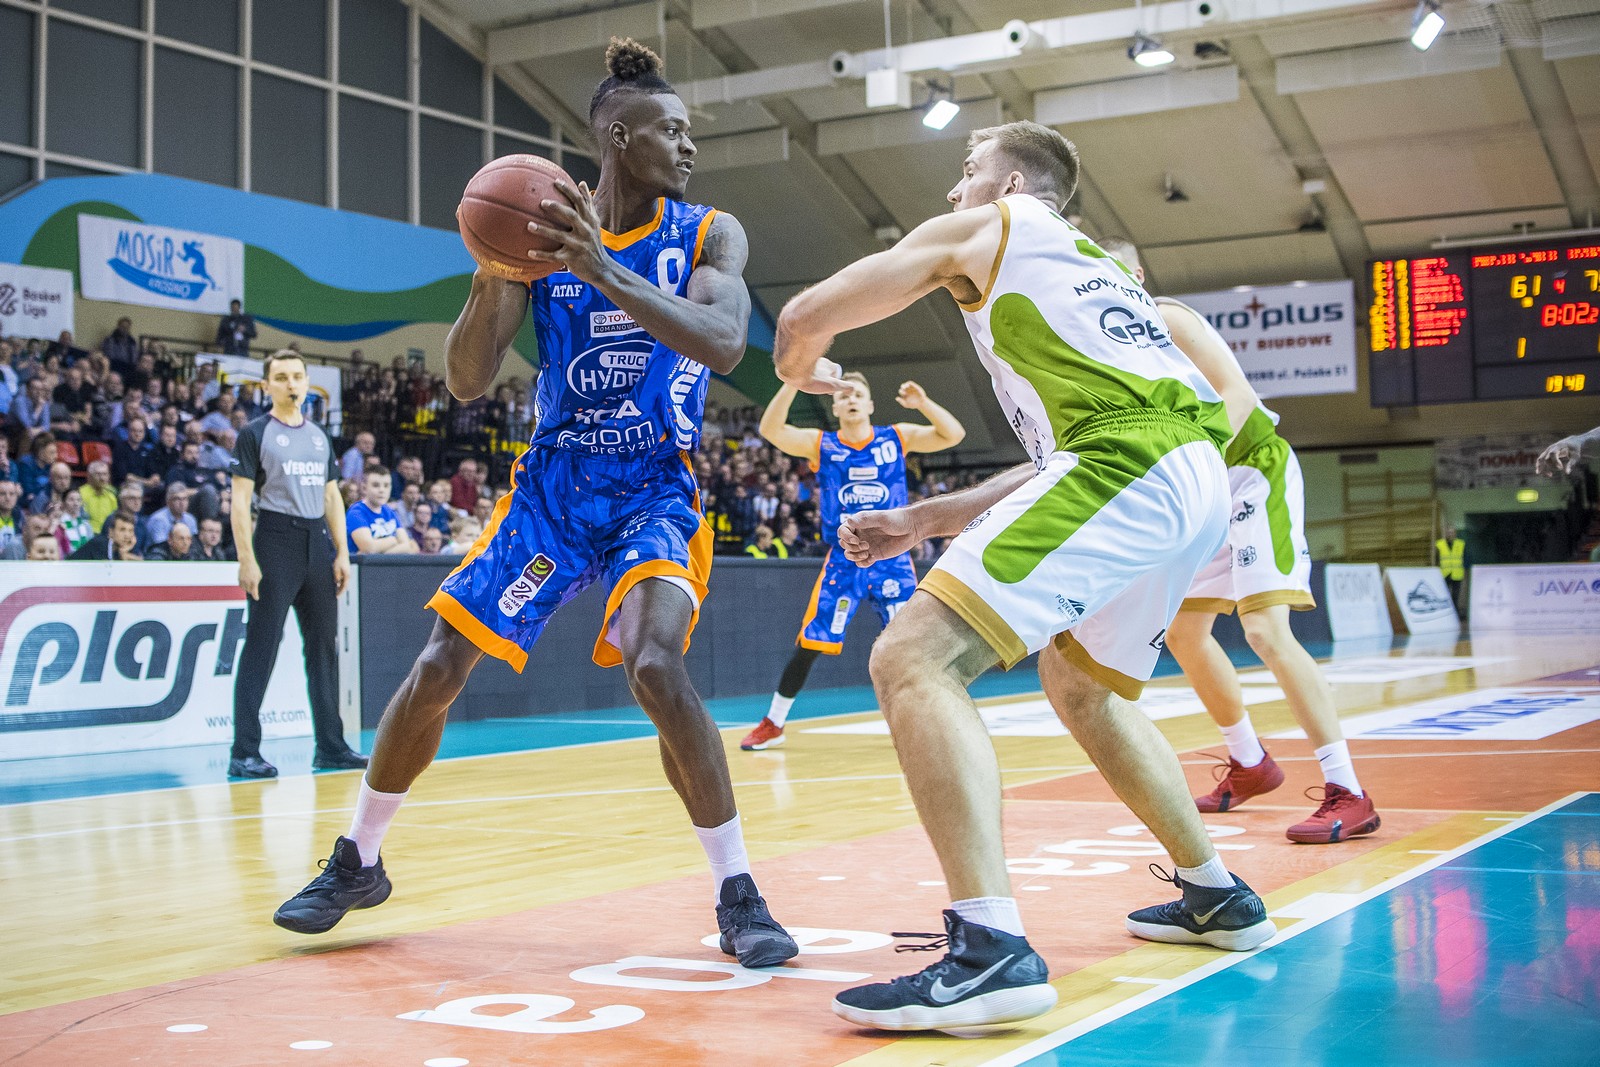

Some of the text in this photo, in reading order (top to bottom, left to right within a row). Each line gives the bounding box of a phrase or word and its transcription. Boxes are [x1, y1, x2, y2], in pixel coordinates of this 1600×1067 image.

[657, 248, 686, 295] 0
[23, 288, 61, 303] Basket
[1510, 275, 1541, 298] 61
[23, 303, 47, 319] Liga
[595, 322, 639, 332] ROMANOWS
[580, 367, 642, 391] HYDR
[870, 440, 898, 466] 10
[282, 459, 325, 475] VERON
